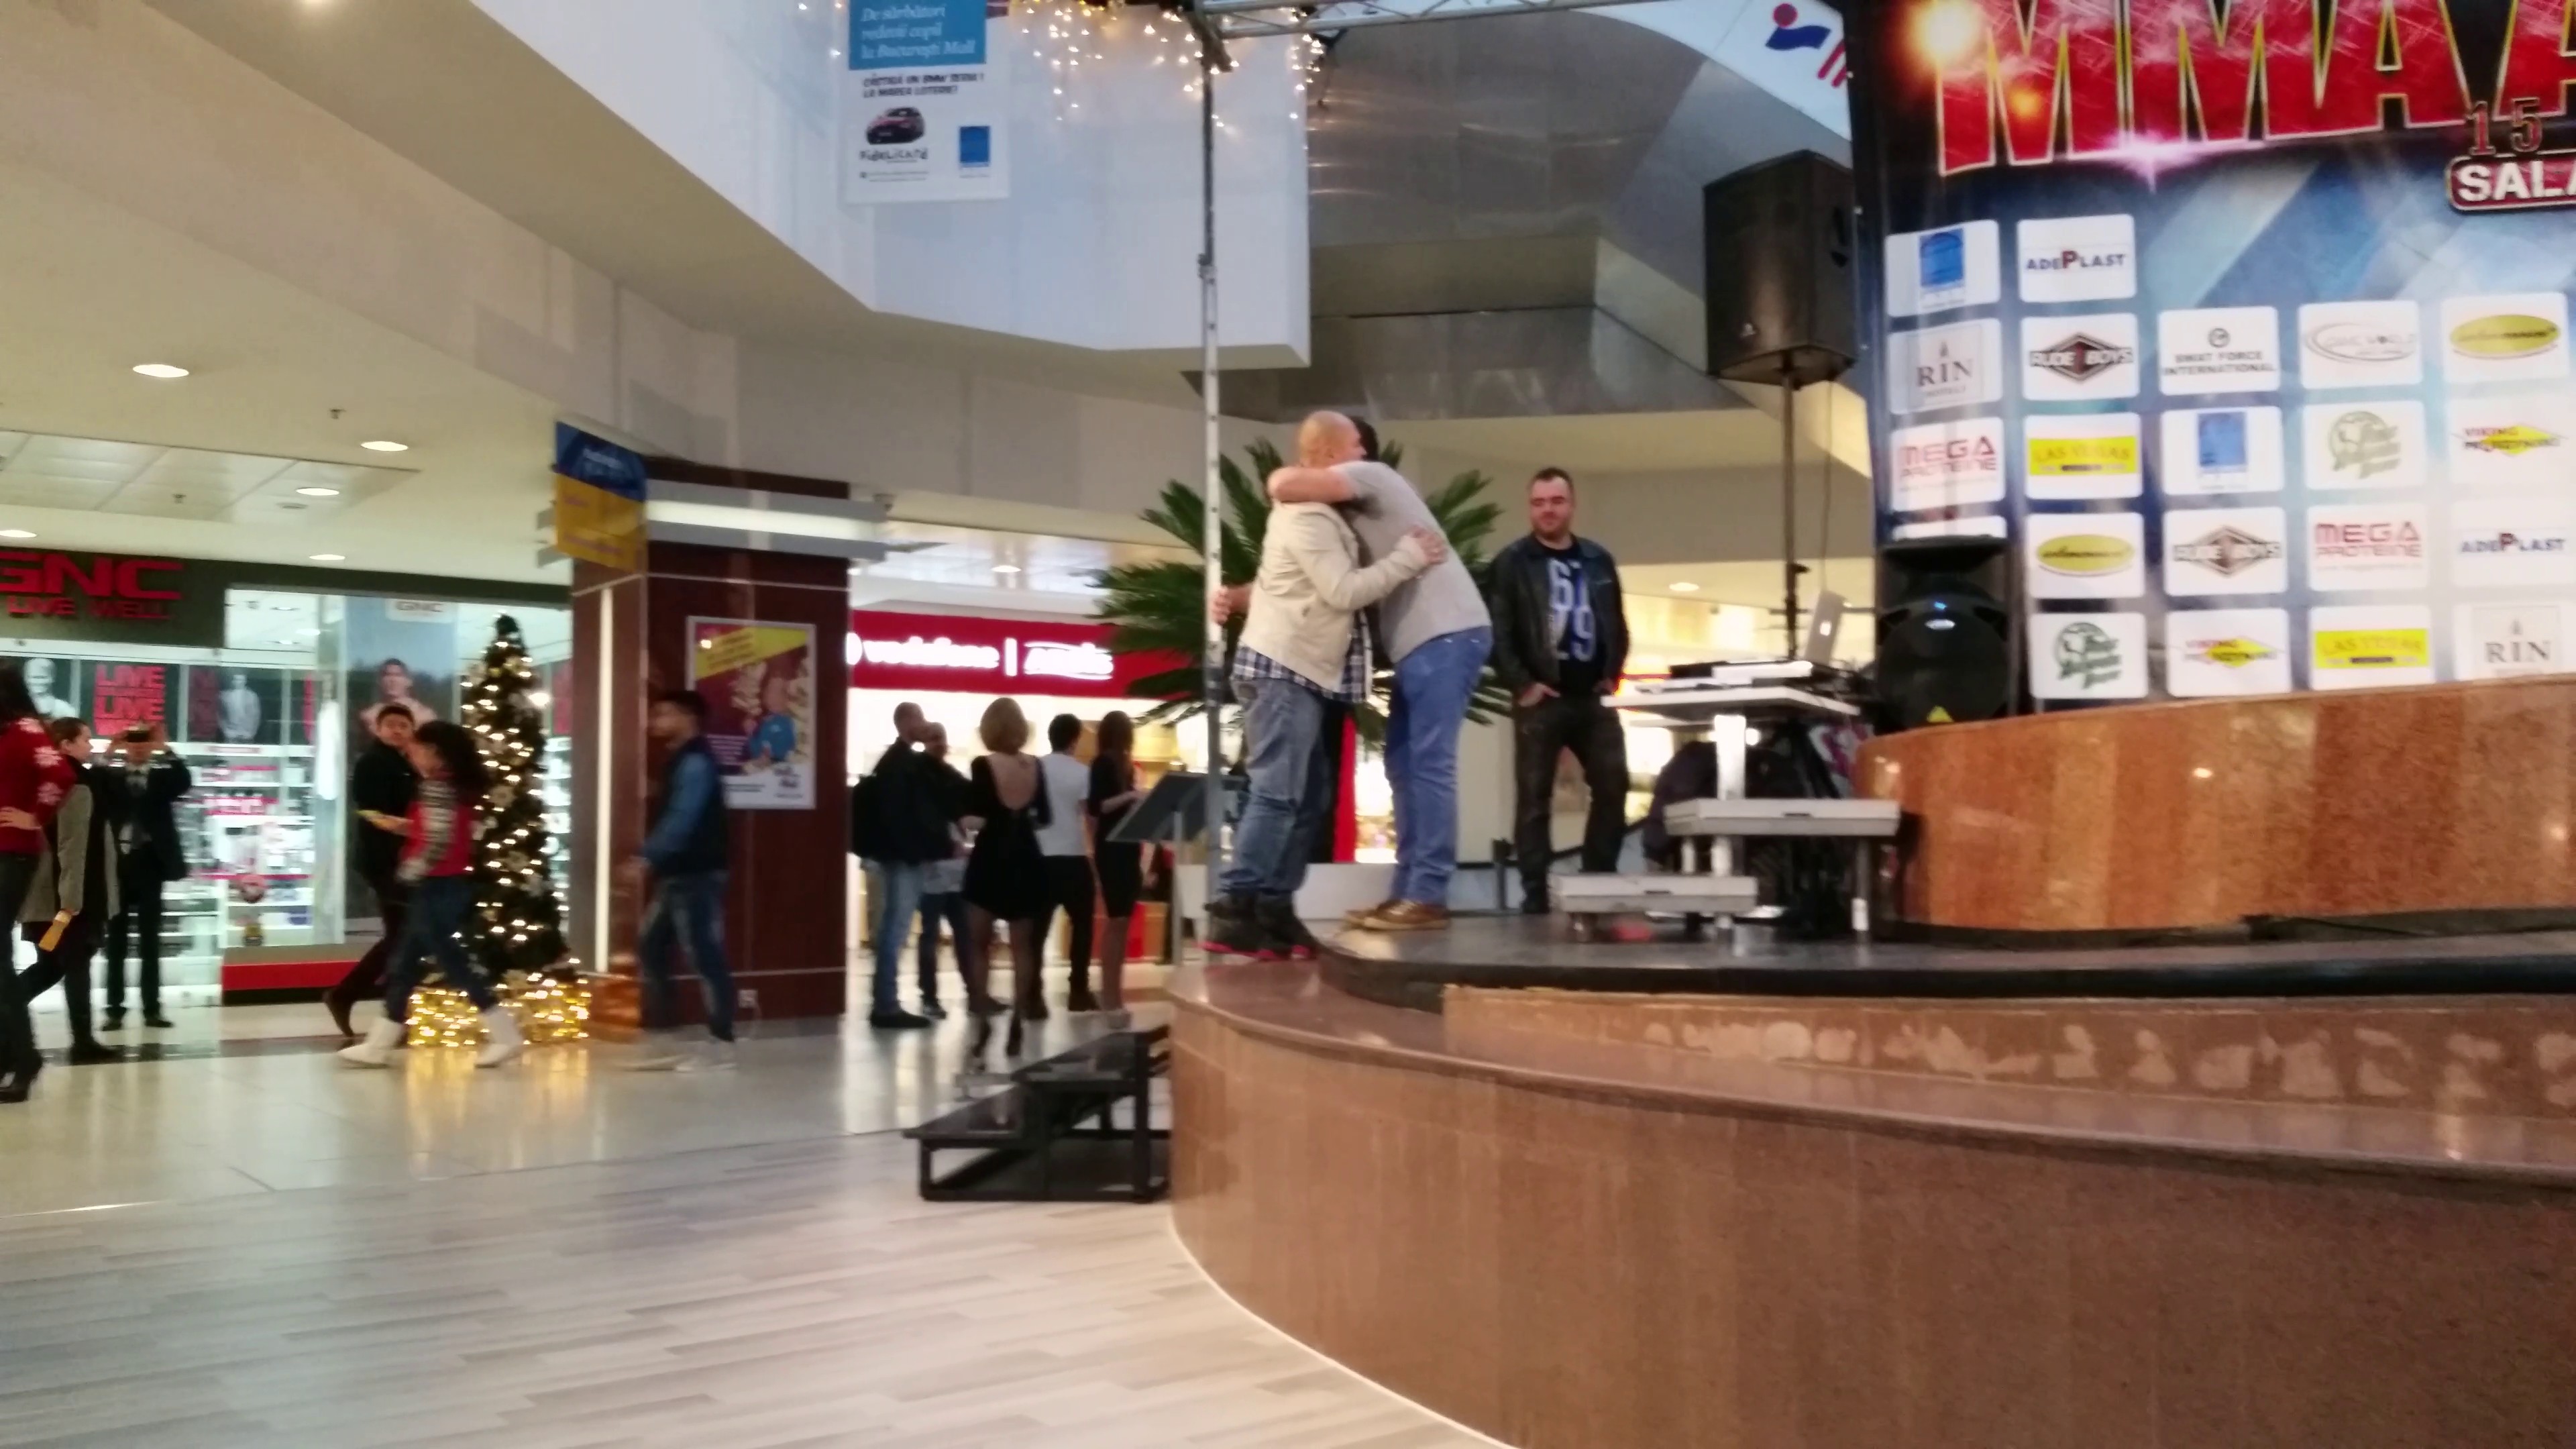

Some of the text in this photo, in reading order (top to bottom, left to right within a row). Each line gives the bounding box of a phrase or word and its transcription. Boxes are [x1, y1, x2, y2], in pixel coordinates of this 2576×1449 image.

[2456, 160, 2576, 202] SAL
[1916, 359, 1973, 387] RIN
[2315, 521, 2420, 545] MEGA
[0, 551, 184, 600] GNC
[2485, 640, 2551, 663] RIN
